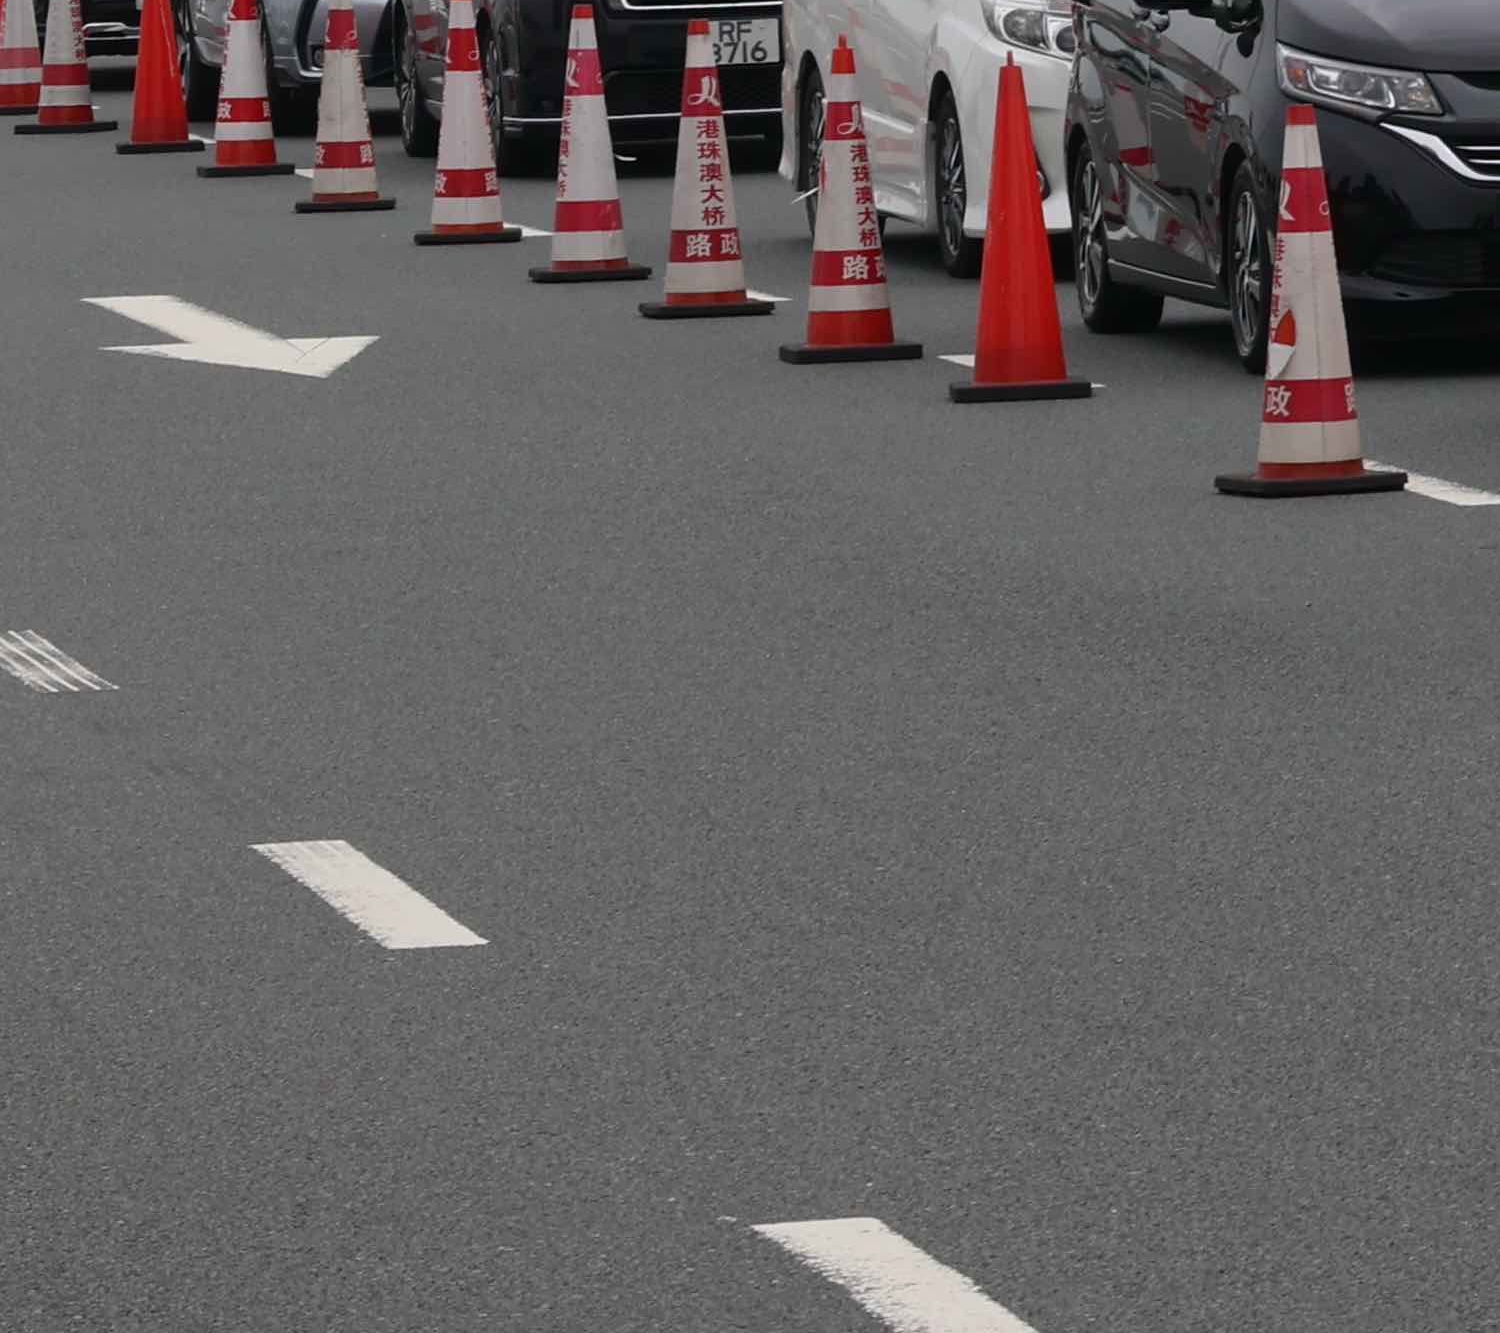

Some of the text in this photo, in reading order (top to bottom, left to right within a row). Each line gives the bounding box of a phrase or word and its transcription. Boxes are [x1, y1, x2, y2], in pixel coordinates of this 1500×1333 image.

[719, 21, 753, 43] RF
[696, 119, 726, 227] 港珠澳大桥
[849, 144, 879, 248] 港珠澳大桥
[685, 233, 740, 258] 路政
